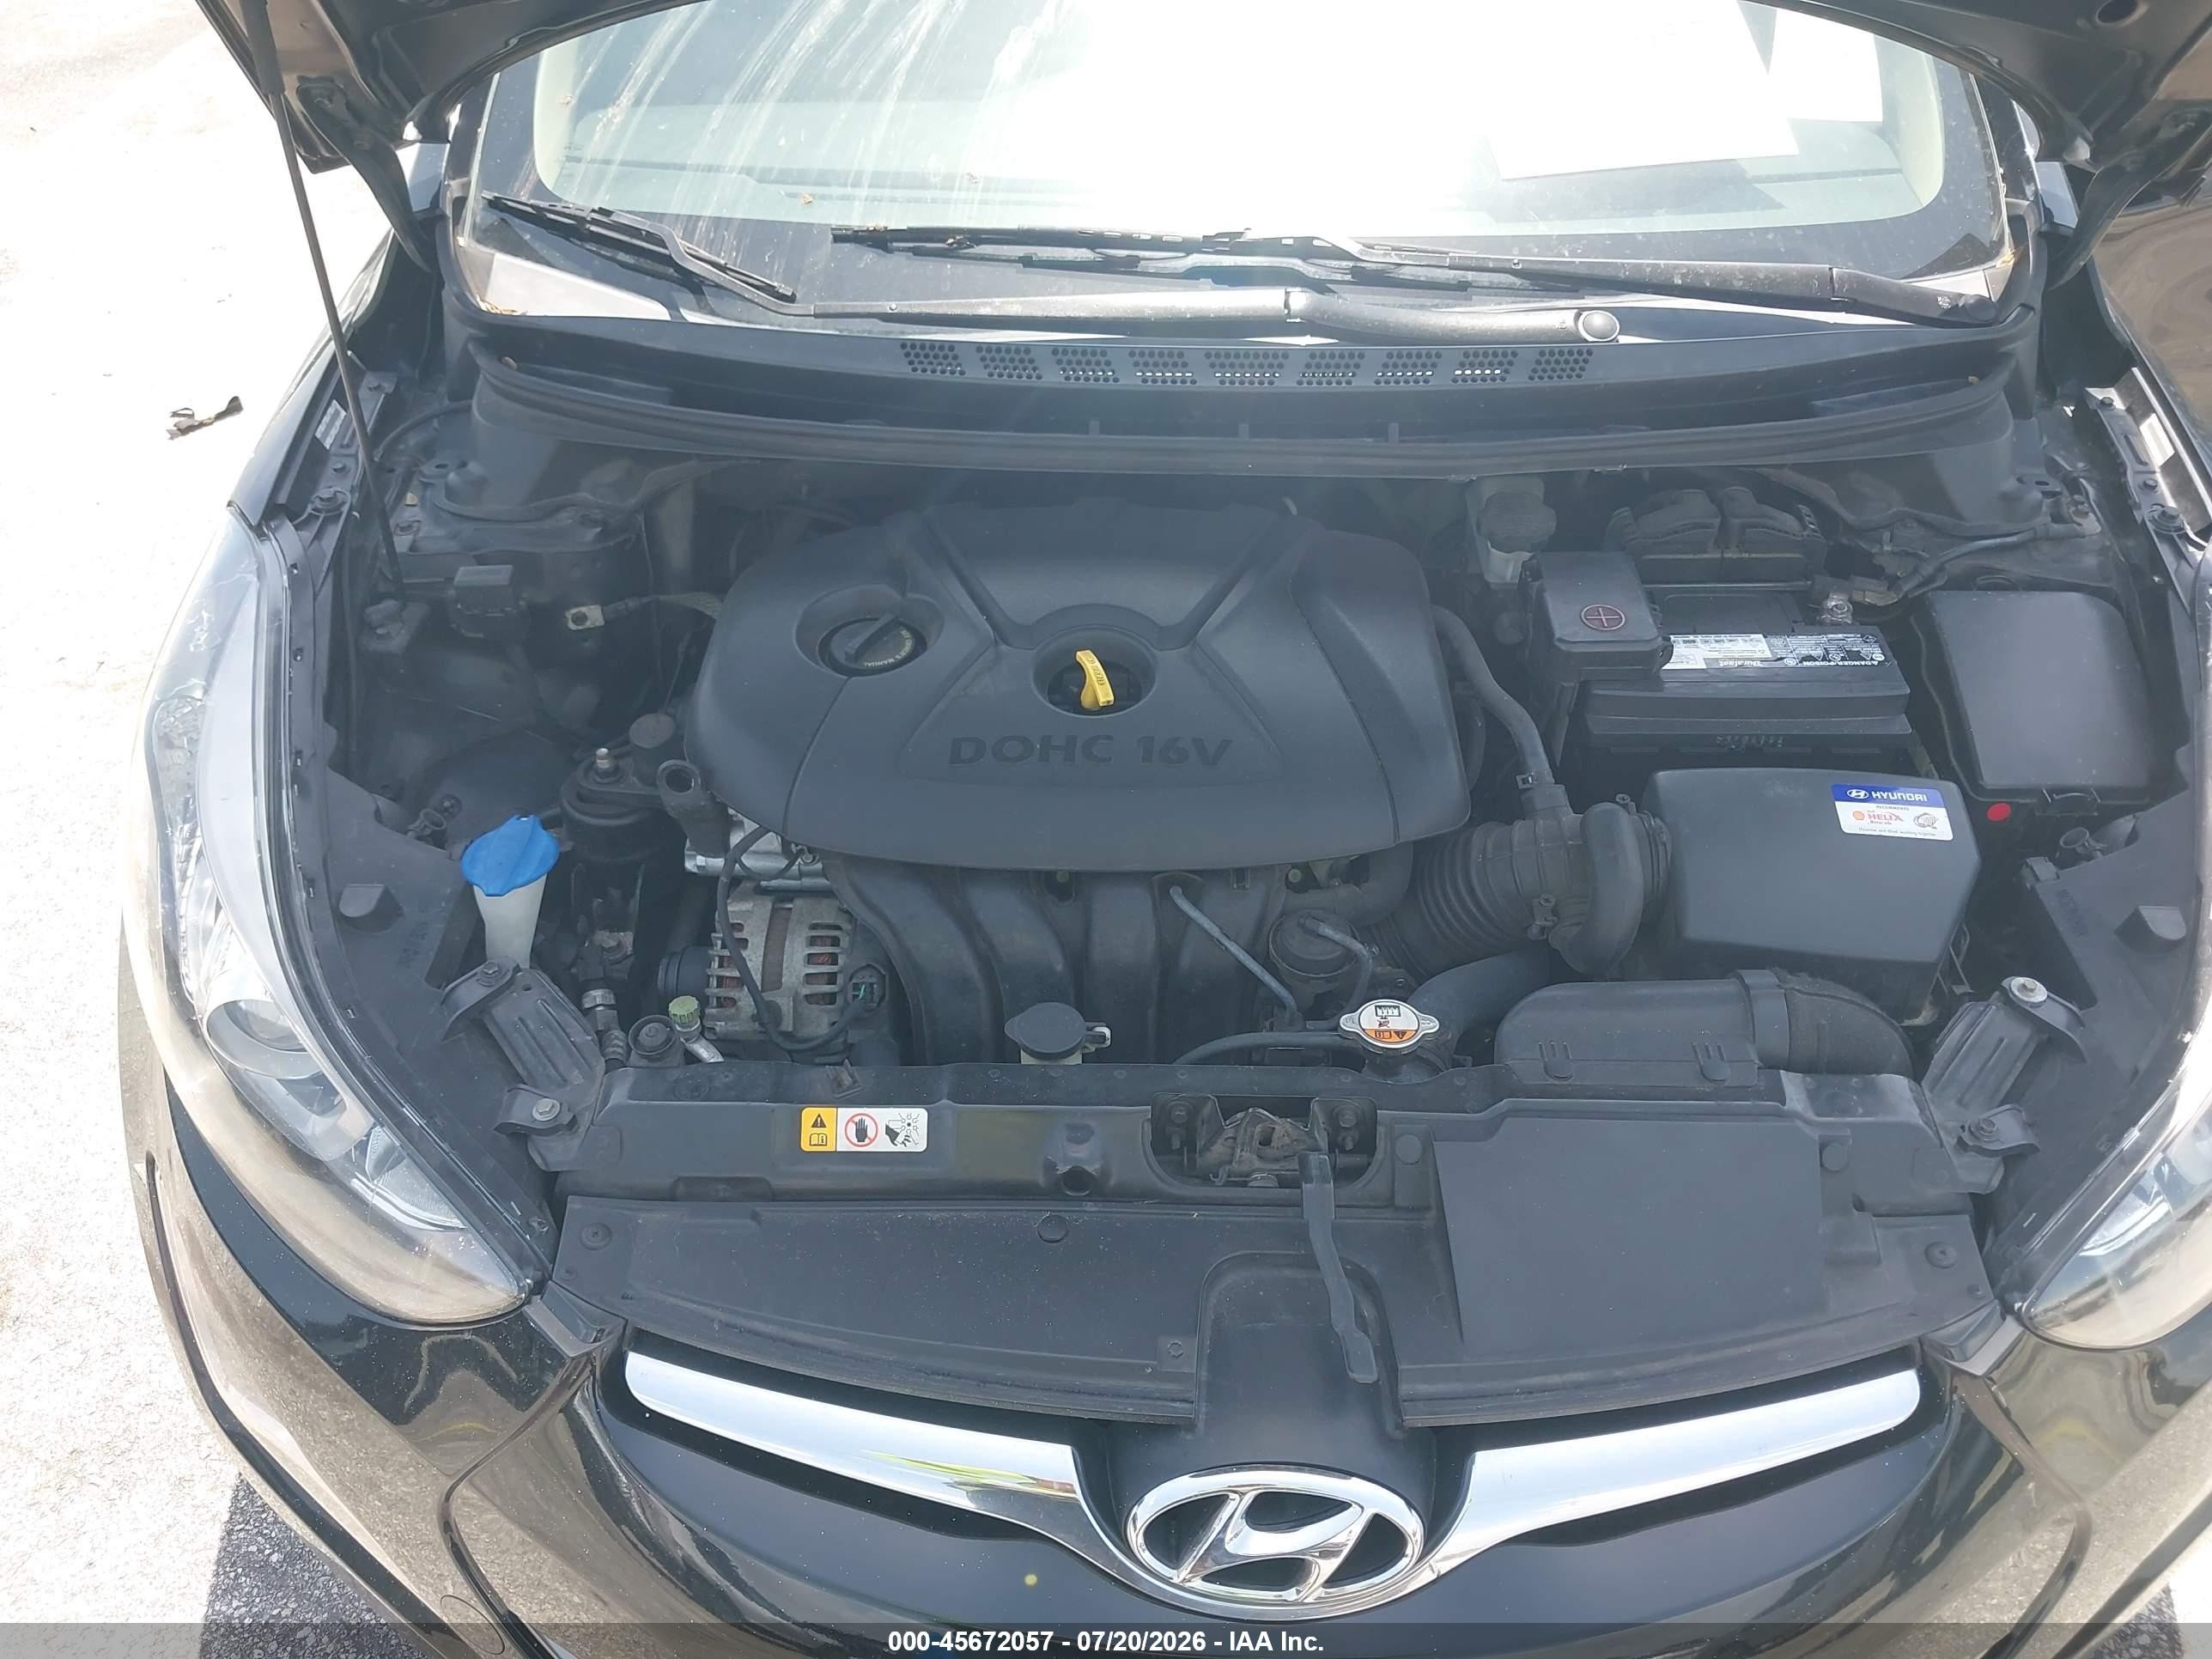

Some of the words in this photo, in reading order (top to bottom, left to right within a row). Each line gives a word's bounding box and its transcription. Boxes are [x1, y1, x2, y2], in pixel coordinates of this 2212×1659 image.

[947, 734, 1114, 764] DOHC
[1136, 735, 1234, 766] 16V
[1871, 791, 1929, 802] HYUNDAI
[1868, 812, 1904, 822] HELIX
